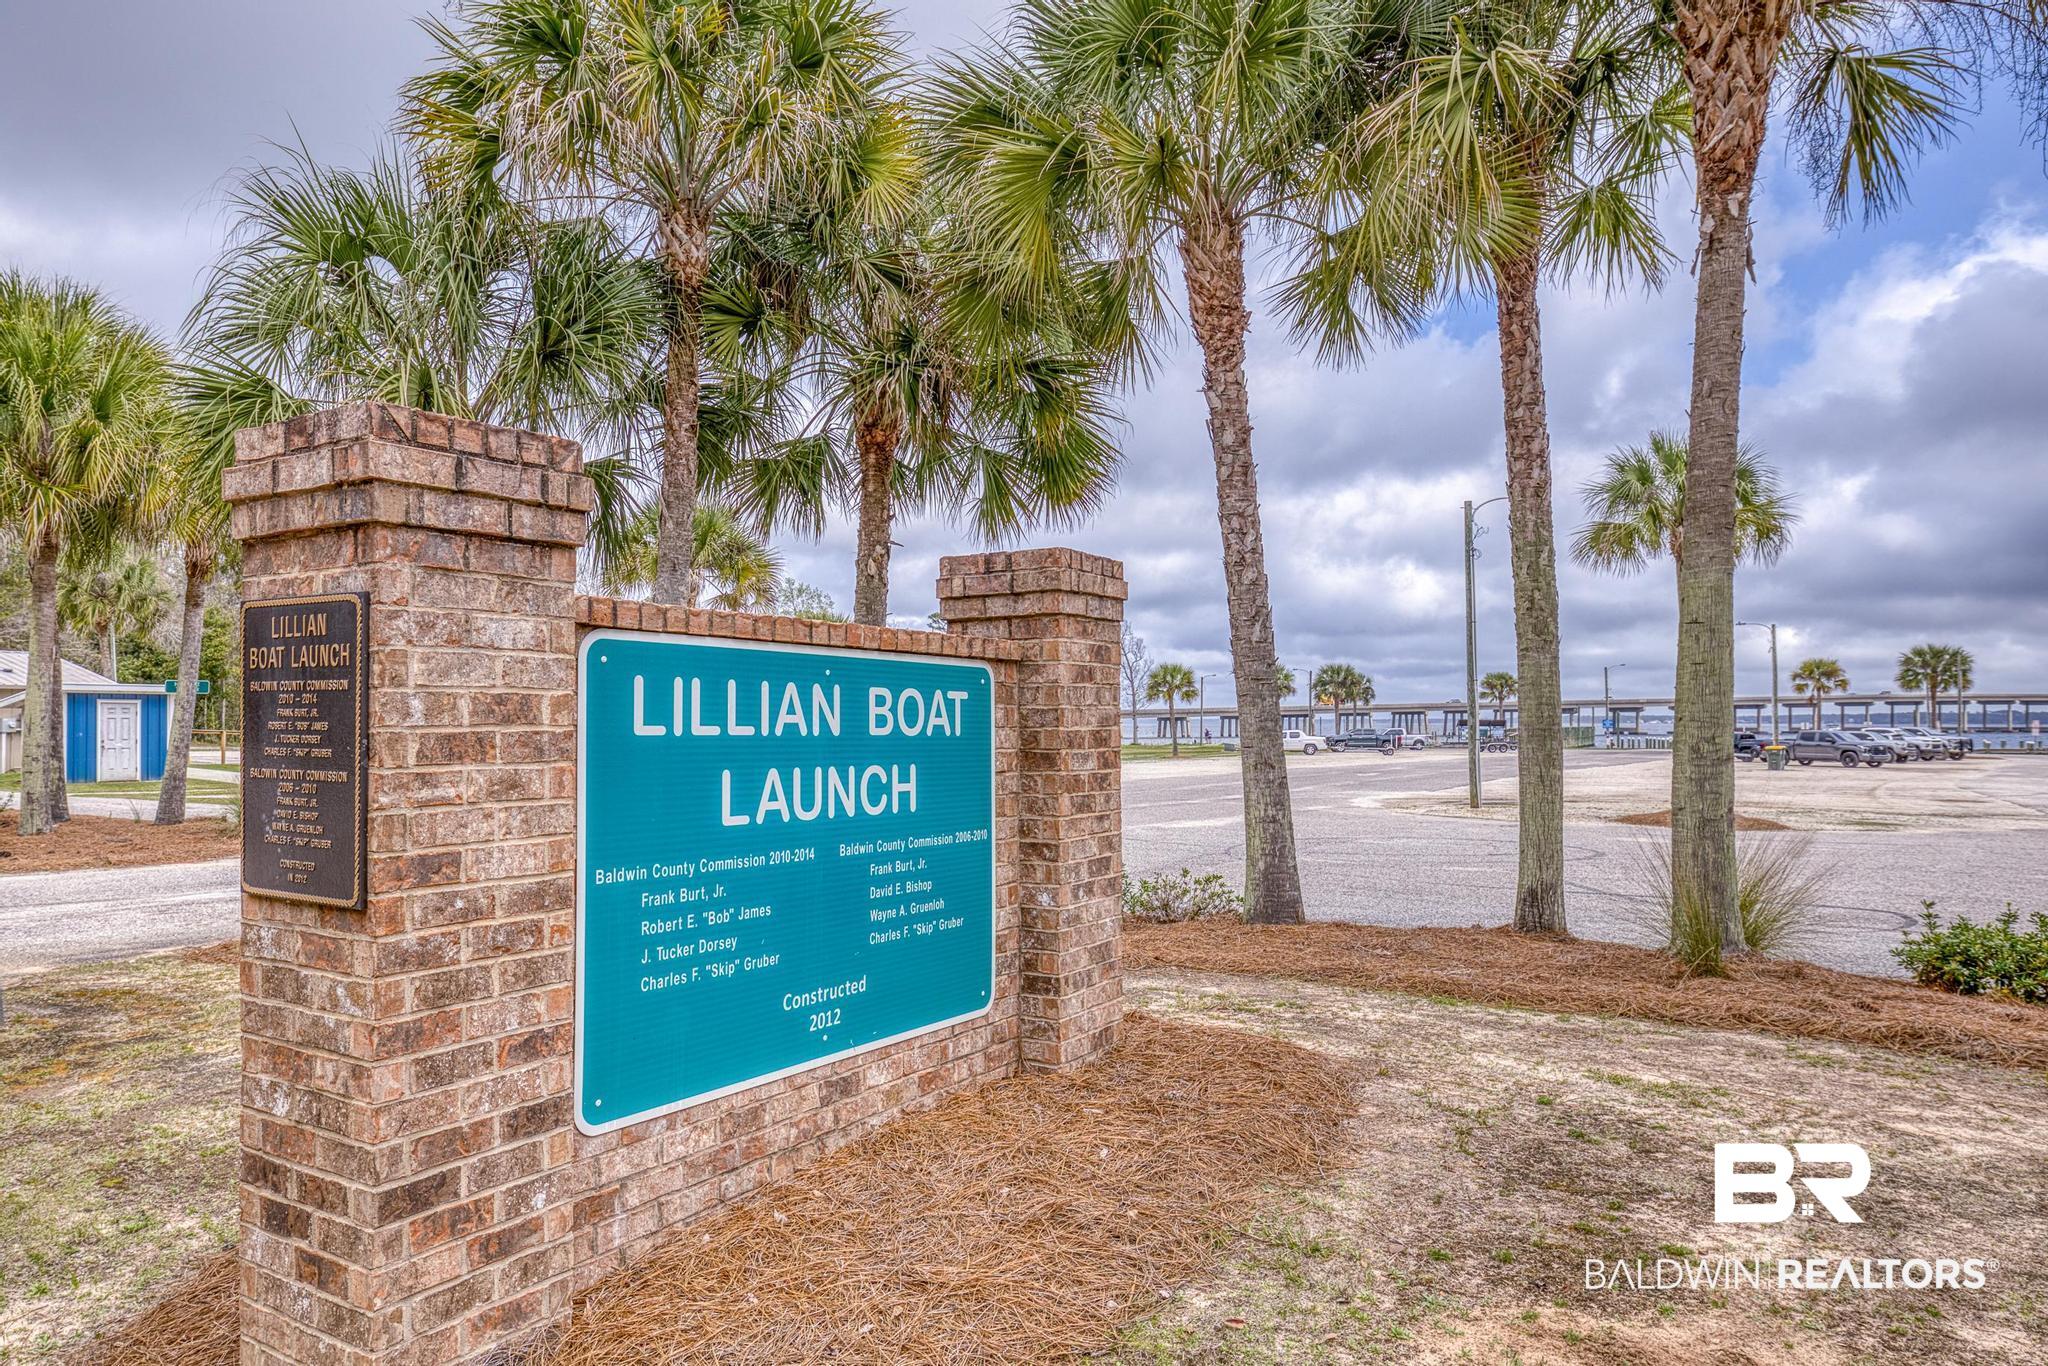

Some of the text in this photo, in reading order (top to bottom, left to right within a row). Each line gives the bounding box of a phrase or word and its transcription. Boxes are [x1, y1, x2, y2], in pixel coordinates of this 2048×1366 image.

[272, 613, 326, 638] LILLIAN
[250, 643, 350, 668] BOAT LAUNCH
[250, 680, 348, 691] BALDWIN COUNTY COMMISSION
[279, 694, 294, 703] 2010
[302, 694, 317, 703] 2014
[634, 675, 968, 736] LILLIAN BOAT
[277, 708, 293, 716] FRANK
[268, 721, 287, 730] ROBERT
[311, 722, 328, 730] JAMES
[280, 735, 299, 743] TUCKER
[301, 735, 321, 743] DORSEY
[264, 747, 286, 756] CHARLES
[311, 749, 332, 757] GRUBER
[250, 768, 348, 782] BALDWIN COUNTY COMMISSION
[301, 783, 316, 793] 2010
[722, 764, 916, 826] LAUNCH
[277, 796, 293, 805] FRANK
[300, 811, 319, 820] BISHOP
[264, 834, 286, 844] CHARLES
[310, 839, 331, 848] GRUBER
[840, 829, 987, 856] Baldwin County Commission 2006-2010
[596, 848, 814, 884] Baldwin County Commission 2010-2014
[870, 858, 926, 875] Frank Burt, Jr.
[642, 884, 726, 907] Frank Burt, Jr.
[870, 880, 932, 899] David E. Bishop
[642, 906, 771, 935] Robert E. "Bob" James
[870, 898, 944, 922] Wayne A. Gruenloh
[870, 917, 963, 944] Charles F. "Skip" Gruber
[642, 937, 737, 964] J. Tucker Dorsey
[641, 954, 779, 992] Charles F. "Skip" Gruber
[783, 975, 866, 1012] Constructed
[810, 1008, 840, 1031] 2012
